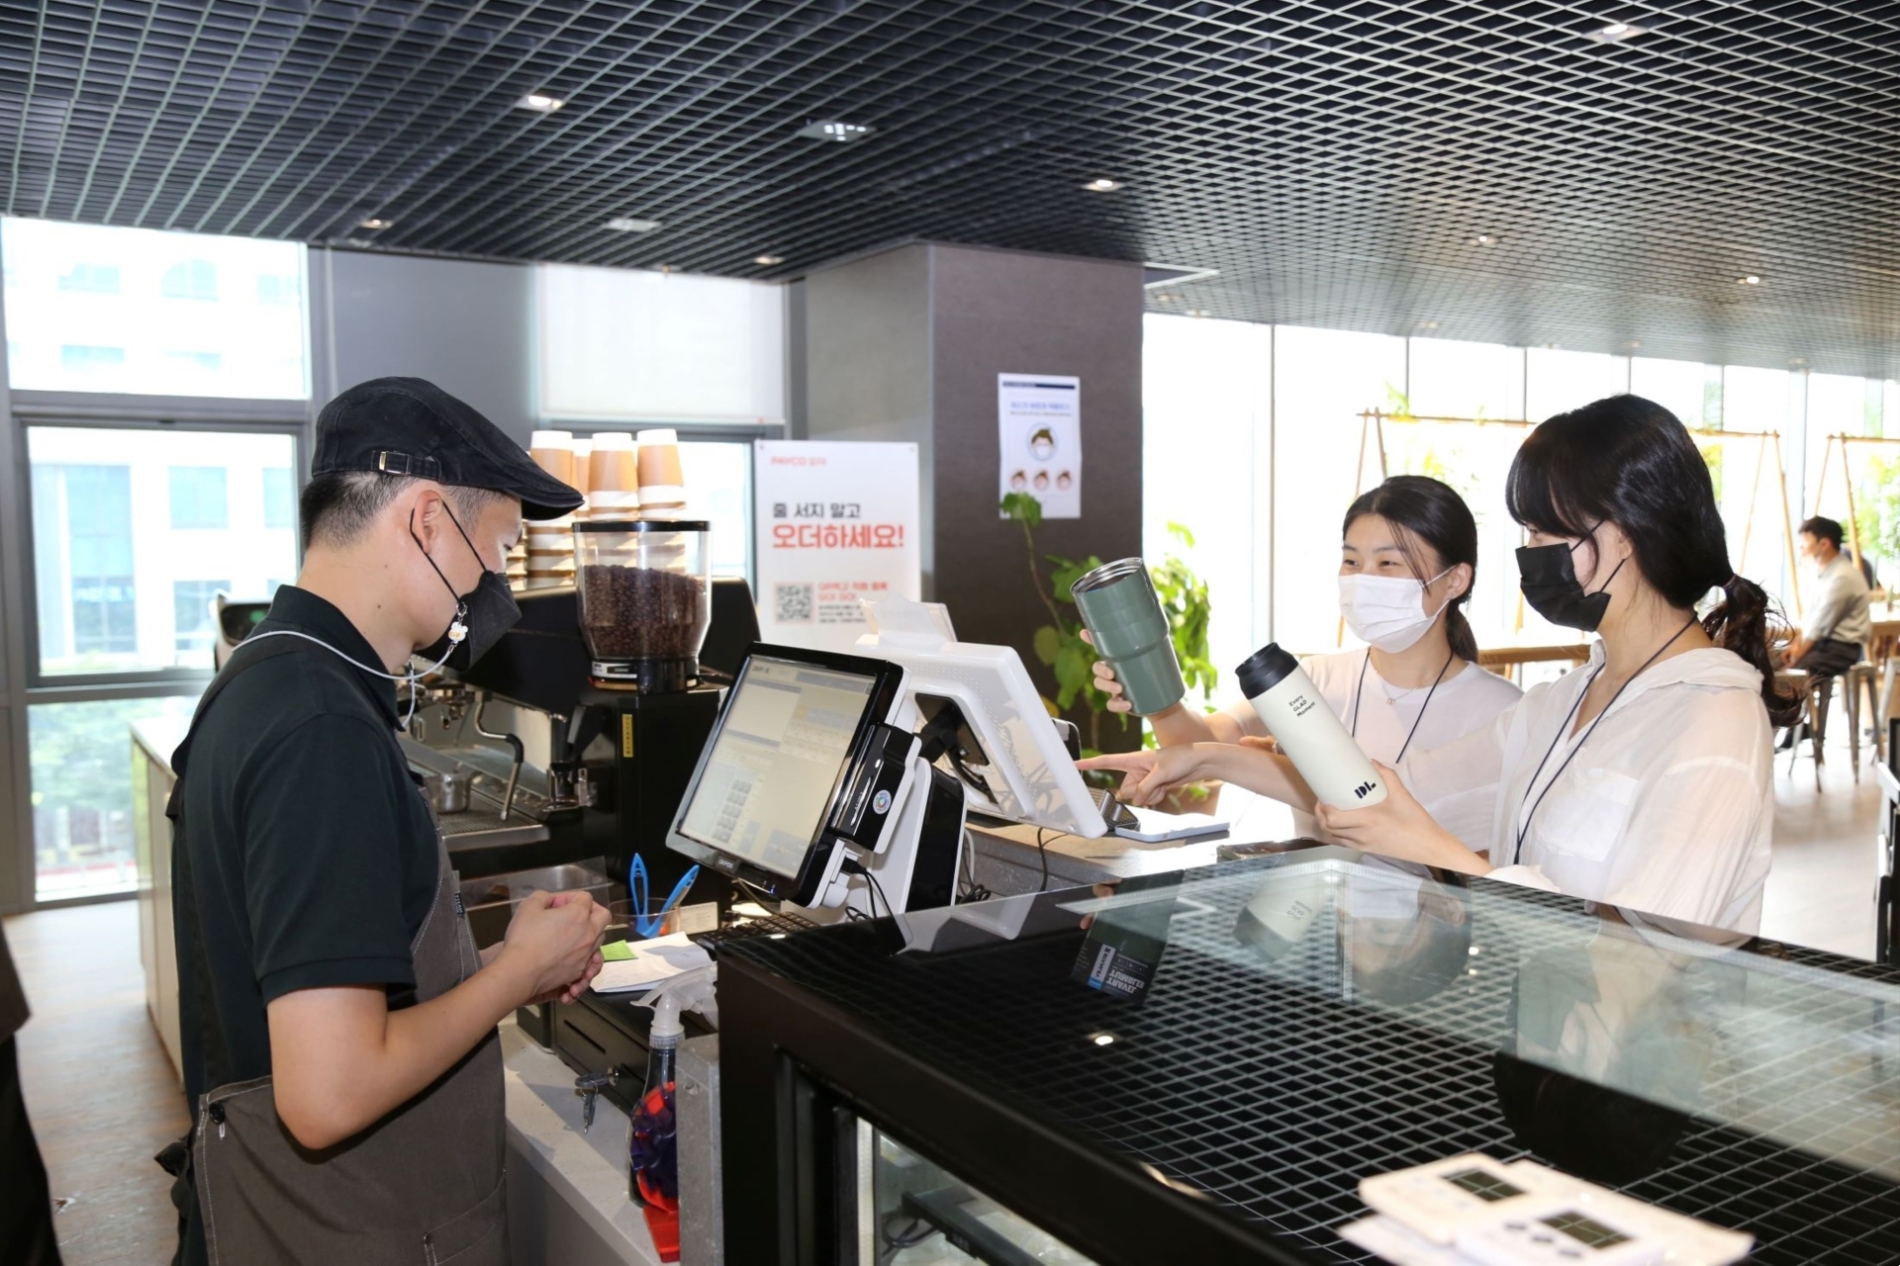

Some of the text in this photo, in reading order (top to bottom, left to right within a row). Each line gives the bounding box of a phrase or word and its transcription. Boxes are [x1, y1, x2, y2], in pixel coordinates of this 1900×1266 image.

[773, 503, 860, 518] 줄 서지 말고
[773, 524, 904, 548] 오더하세요!
[1289, 694, 1304, 707] Every
[1292, 699, 1308, 712] GLAD
[1296, 701, 1316, 717] Moment
